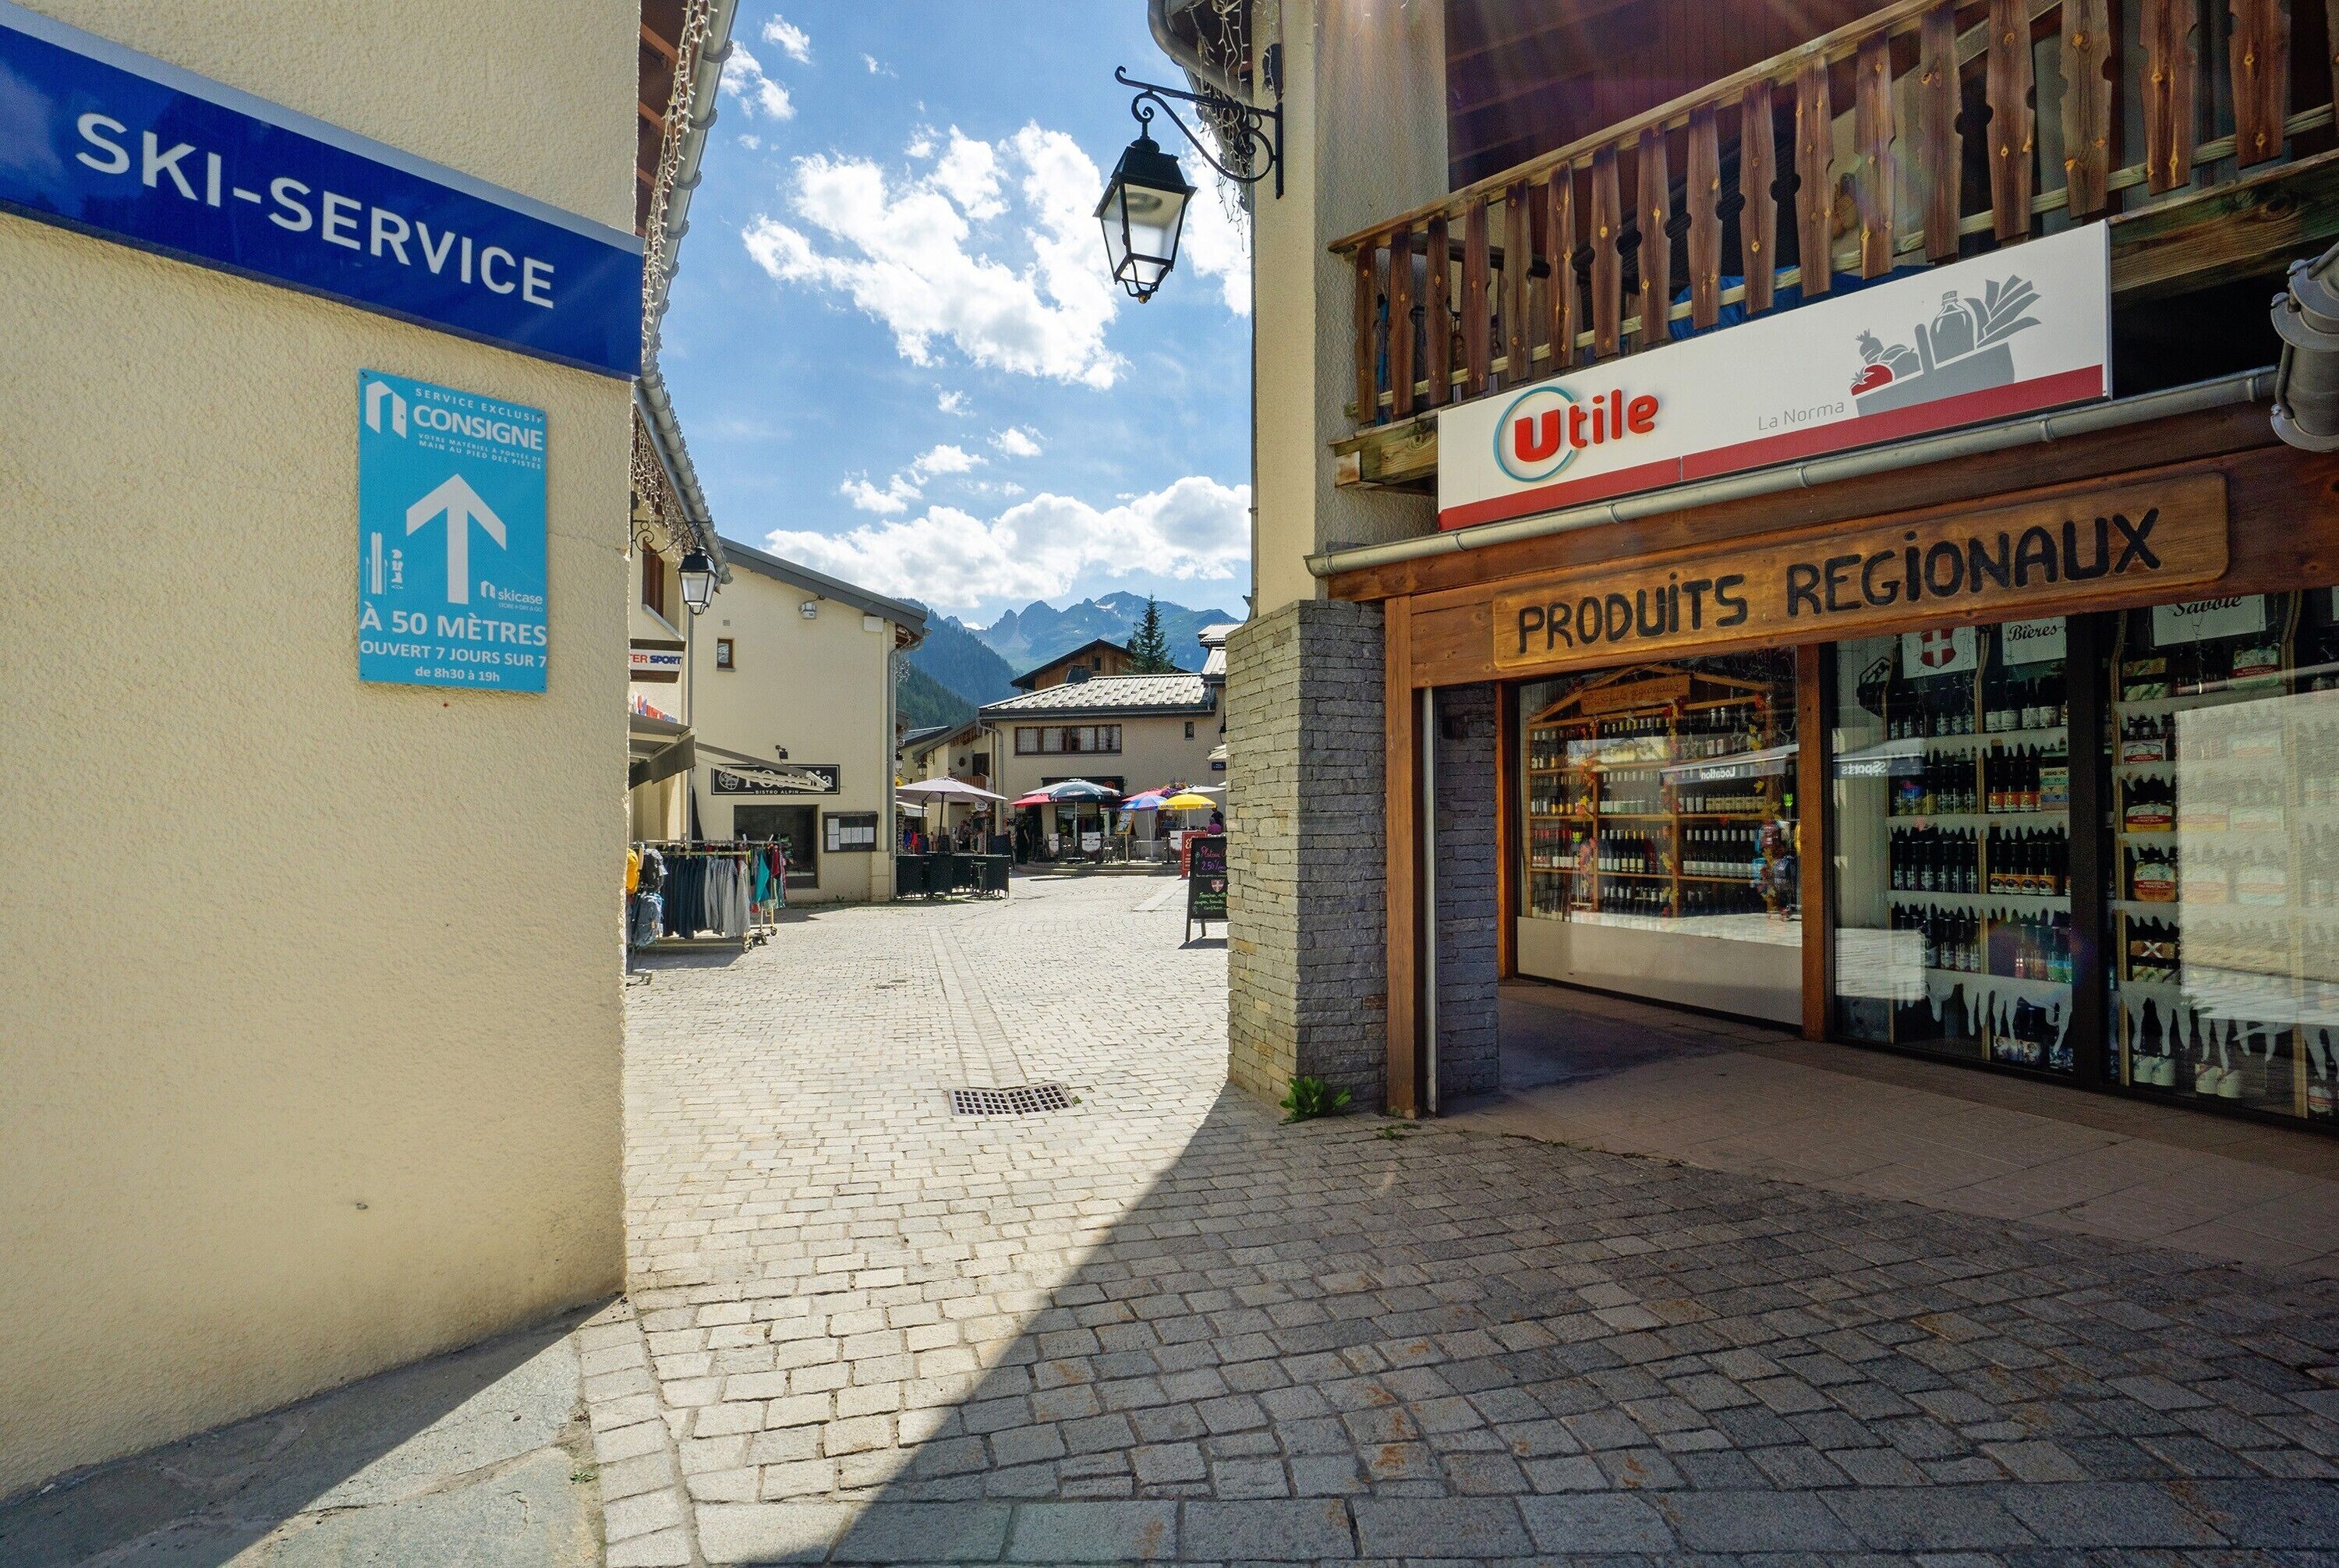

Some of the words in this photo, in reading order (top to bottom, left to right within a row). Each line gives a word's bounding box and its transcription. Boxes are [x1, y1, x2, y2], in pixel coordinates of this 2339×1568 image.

[76, 111, 555, 309] SKI-SERVICE
[415, 388, 474, 409] SERVICE
[413, 405, 543, 451] CONSIGNE
[1514, 389, 1658, 462] Utile
[1759, 416, 1778, 430] La
[1784, 402, 1845, 425] Norma
[418, 433, 445, 444] VOTRE
[419, 440, 444, 451] MAIN
[466, 449, 488, 459] PIED
[491, 455, 508, 463] DES
[511, 458, 542, 469] PISTES
[498, 588, 543, 605] skicase
[359, 601, 383, 632] À
[392, 611, 428, 635] 50
[437, 612, 547, 646] MÈTRES
[2008, 625, 2058, 641] Bières
[360, 640, 431, 659] OUVERT
[436, 647, 445, 660] 7
[450, 648, 501, 664] JOURS
[504, 653, 534, 667] SUR
[538, 656, 547, 667] 7
[630, 654, 648, 663] ER
[649, 655, 682, 664] SPORT
[415, 666, 431, 677] de
[434, 667, 465, 679] 8h30
[468, 669, 476, 681] à
[479, 671, 500, 681] 19h
